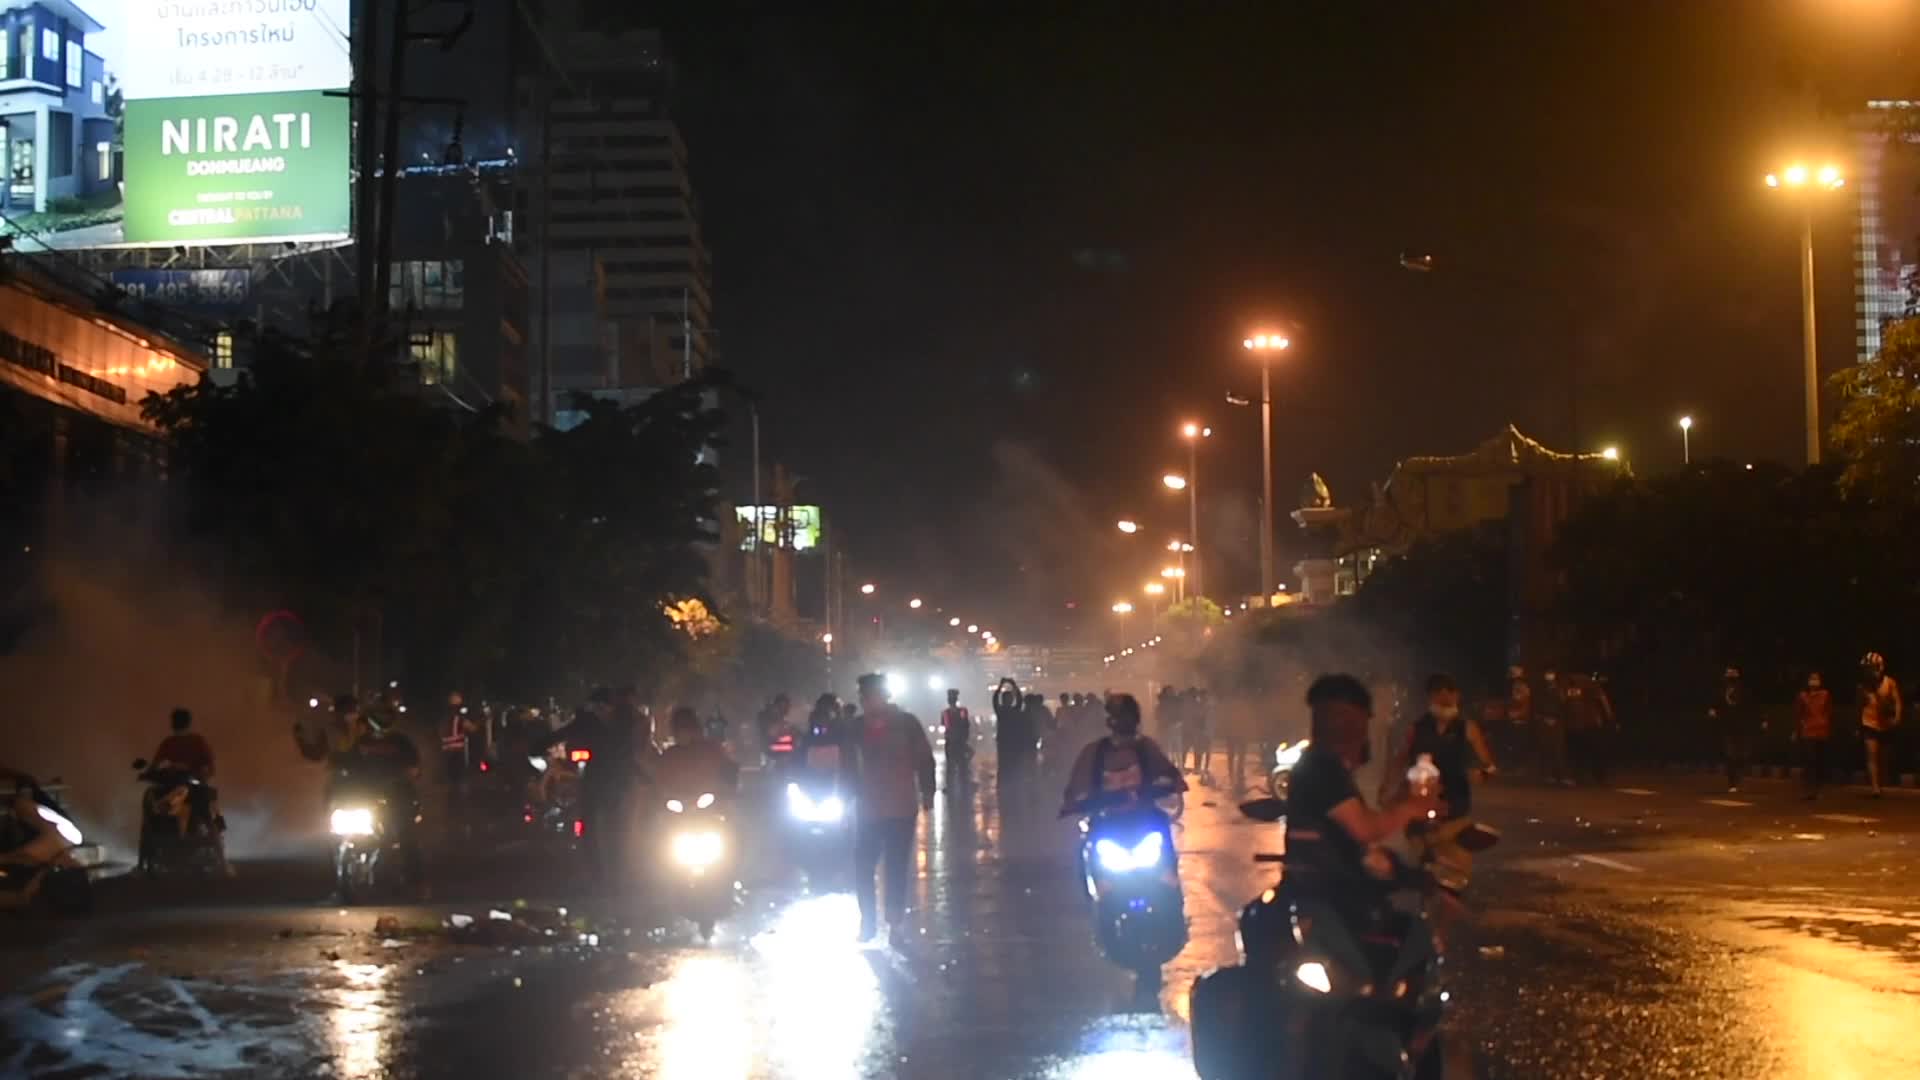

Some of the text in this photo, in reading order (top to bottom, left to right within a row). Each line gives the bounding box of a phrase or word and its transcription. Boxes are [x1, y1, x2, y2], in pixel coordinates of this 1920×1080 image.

[177, 22, 294, 47] โครงการใหม่
[162, 112, 311, 155] NIRATI
[187, 156, 285, 176] DONMUEANG
